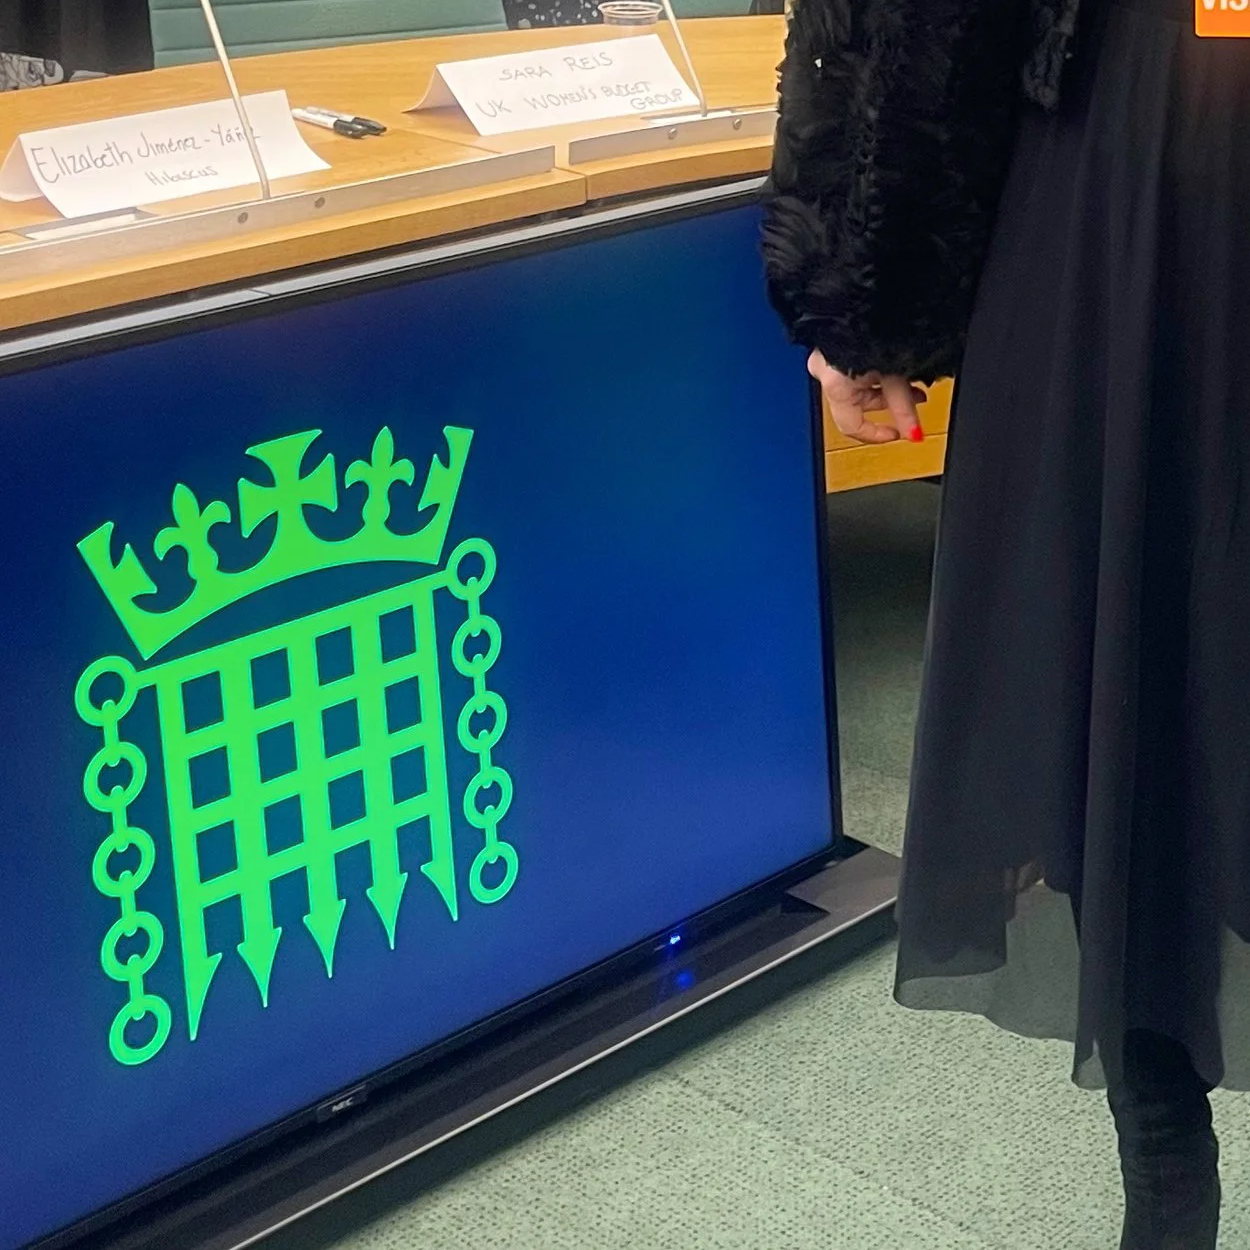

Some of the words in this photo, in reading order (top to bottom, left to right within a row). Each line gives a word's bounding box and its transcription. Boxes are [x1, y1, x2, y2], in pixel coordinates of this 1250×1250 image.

[499, 65, 552, 81] SARA
[563, 52, 614, 72] REIS
[475, 98, 512, 118] UK
[630, 88, 684, 111] GROUP
[30, 141, 133, 184] Elizabeth
